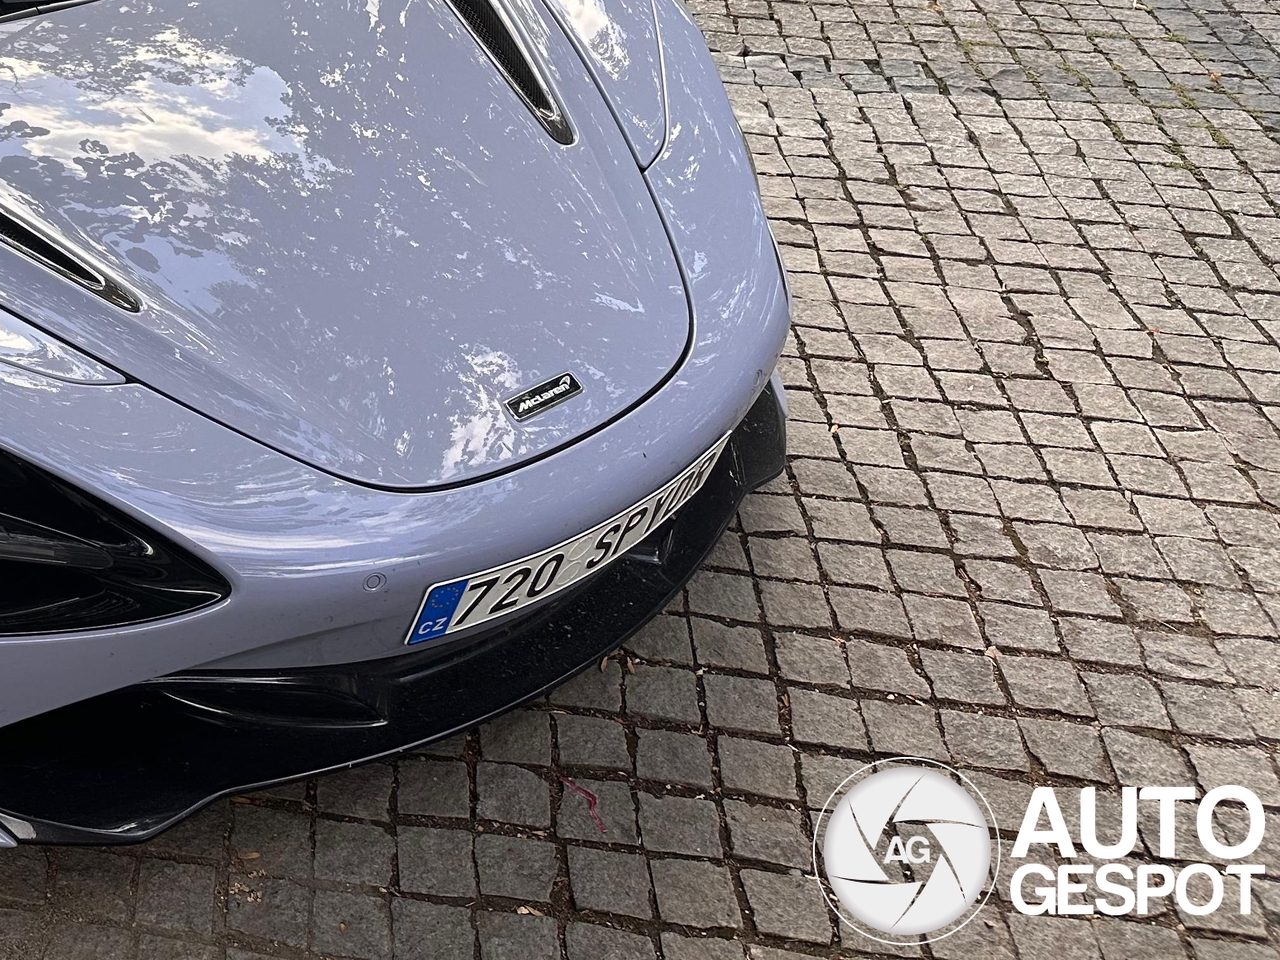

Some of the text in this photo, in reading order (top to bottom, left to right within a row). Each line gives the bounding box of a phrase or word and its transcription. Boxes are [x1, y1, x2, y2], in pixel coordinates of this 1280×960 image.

[453, 451, 717, 627] 720 SPYDR
[418, 617, 448, 635] CZ
